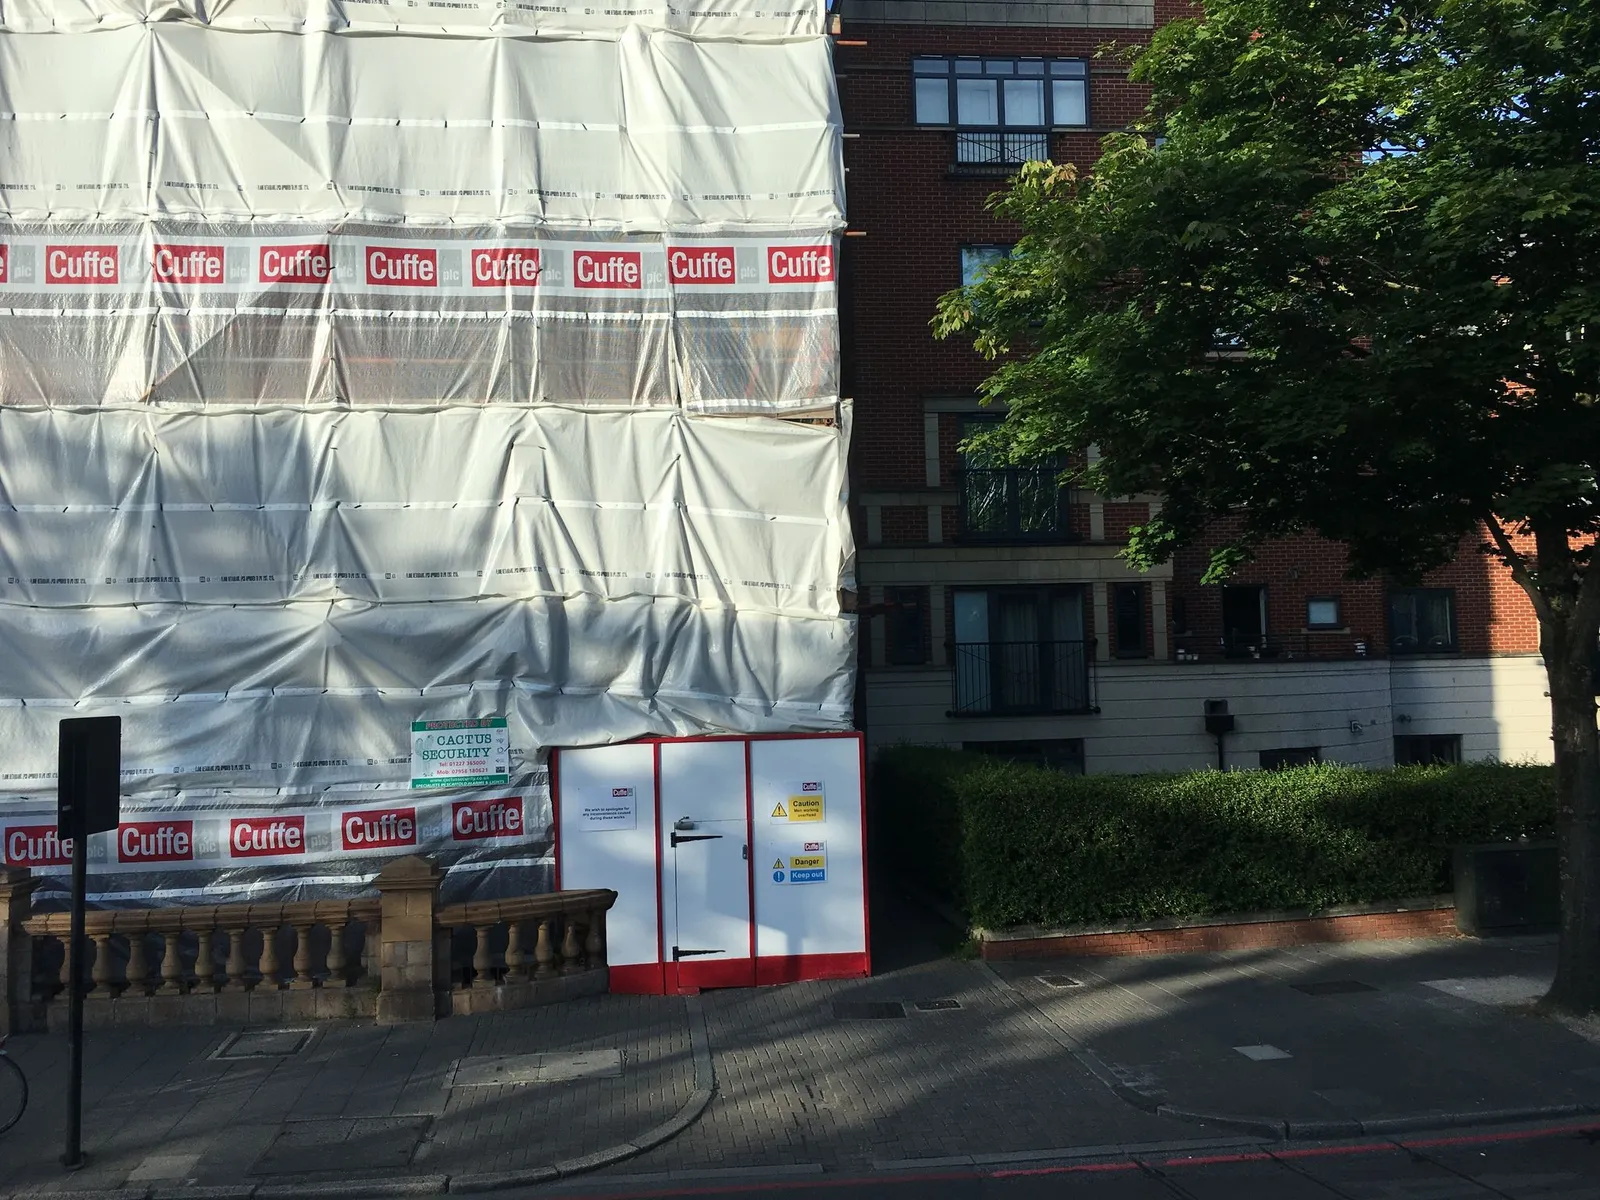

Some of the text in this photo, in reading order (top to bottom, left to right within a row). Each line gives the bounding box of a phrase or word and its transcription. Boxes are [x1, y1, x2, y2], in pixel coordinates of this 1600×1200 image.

[49, 250, 115, 278] Cuffe
[155, 249, 221, 278] Cuffe
[263, 250, 327, 278] Cuffe
[370, 251, 460, 282] Cuffe plc
[475, 253, 536, 281] Cuffe
[577, 255, 663, 284] Cuffe plc
[671, 251, 757, 279] Cuffe plc
[771, 251, 831, 277] Cuffe
[422, 747, 491, 760] SECURITY
[437, 734, 492, 746] CACTUS
[346, 814, 413, 844] Cuffe
[456, 804, 519, 835] Cuffe
[122, 826, 189, 857] Cuffe
[234, 822, 301, 851] Cuffe
